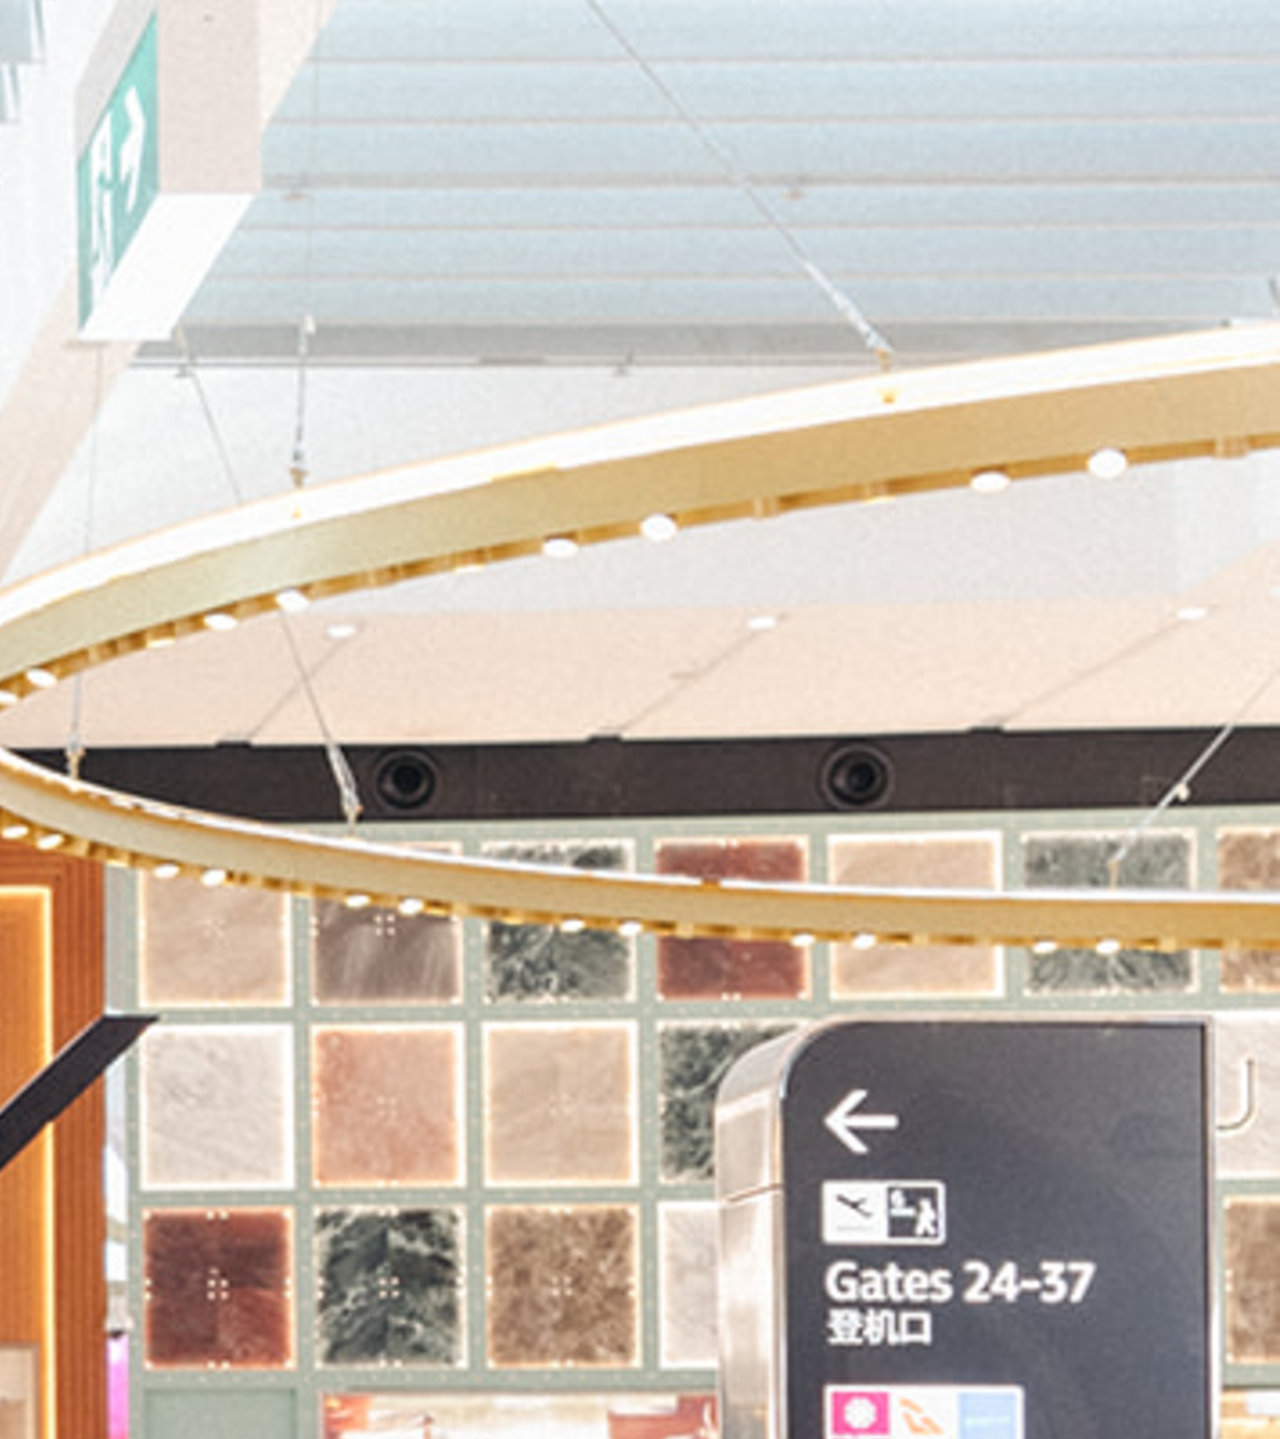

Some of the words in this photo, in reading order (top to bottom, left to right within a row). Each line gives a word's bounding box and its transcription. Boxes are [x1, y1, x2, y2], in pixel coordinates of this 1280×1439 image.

[825, 1260, 954, 1304] Gates
[963, 1260, 1096, 1304] 24-37
[826, 1308, 932, 1346] 登机口
